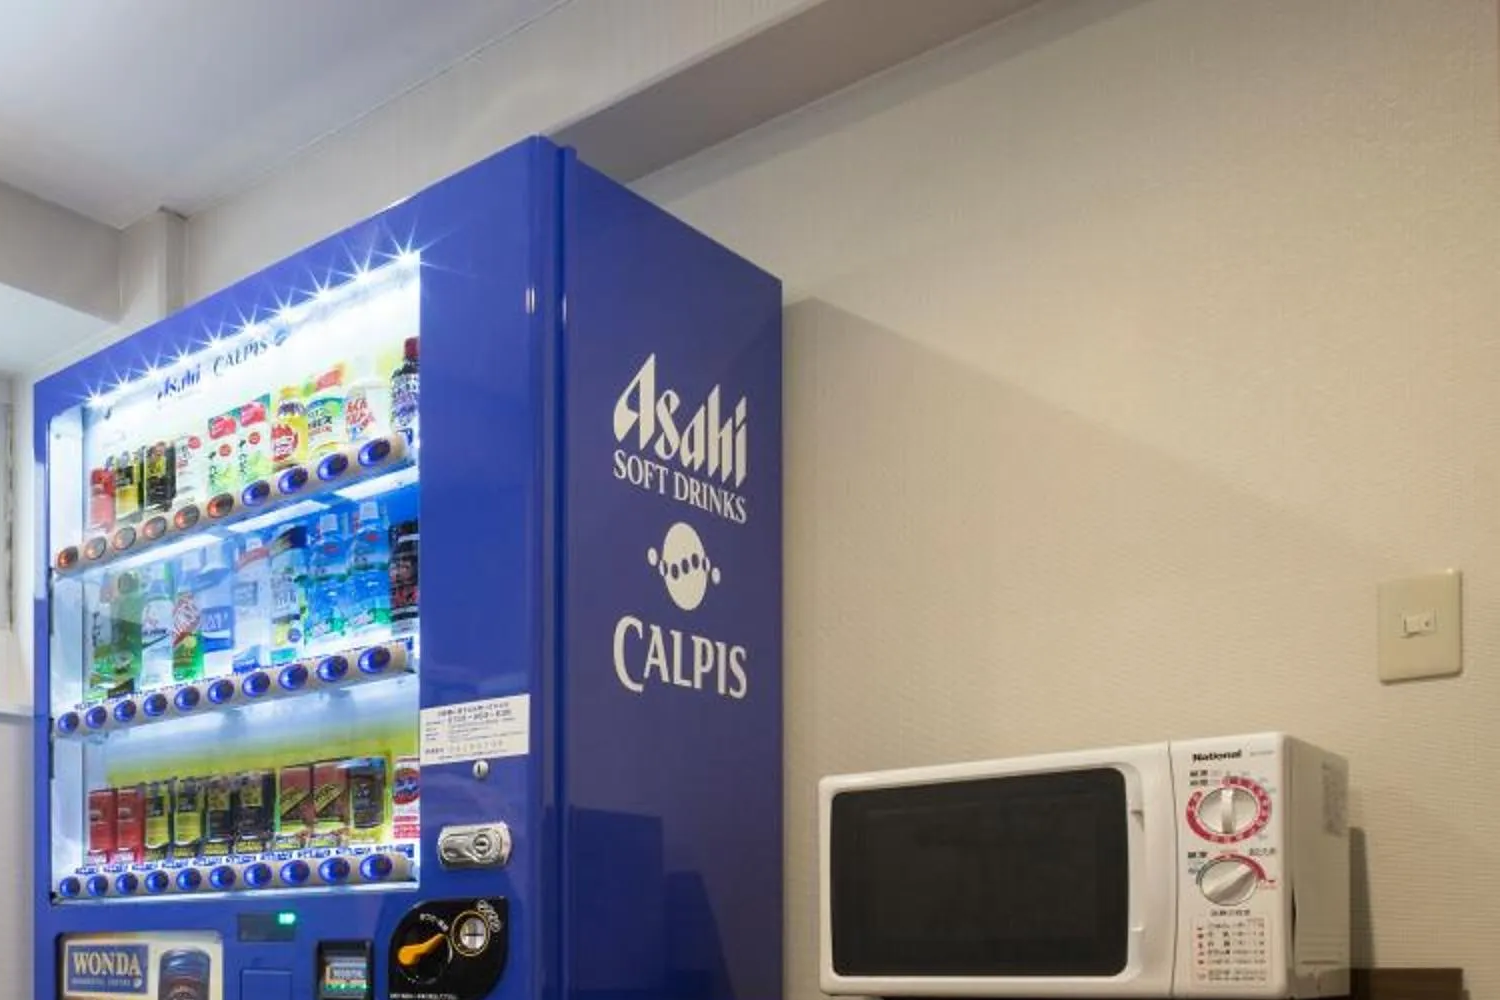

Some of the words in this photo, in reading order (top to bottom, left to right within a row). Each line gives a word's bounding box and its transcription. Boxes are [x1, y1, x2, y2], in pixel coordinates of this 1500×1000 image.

[613, 353, 747, 488] Asahi
[613, 450, 669, 496] SOFT
[674, 471, 747, 525] DRINKS
[613, 615, 747, 699] CALPIS
[1193, 749, 1242, 761] National
[73, 952, 142, 976] WONDA
